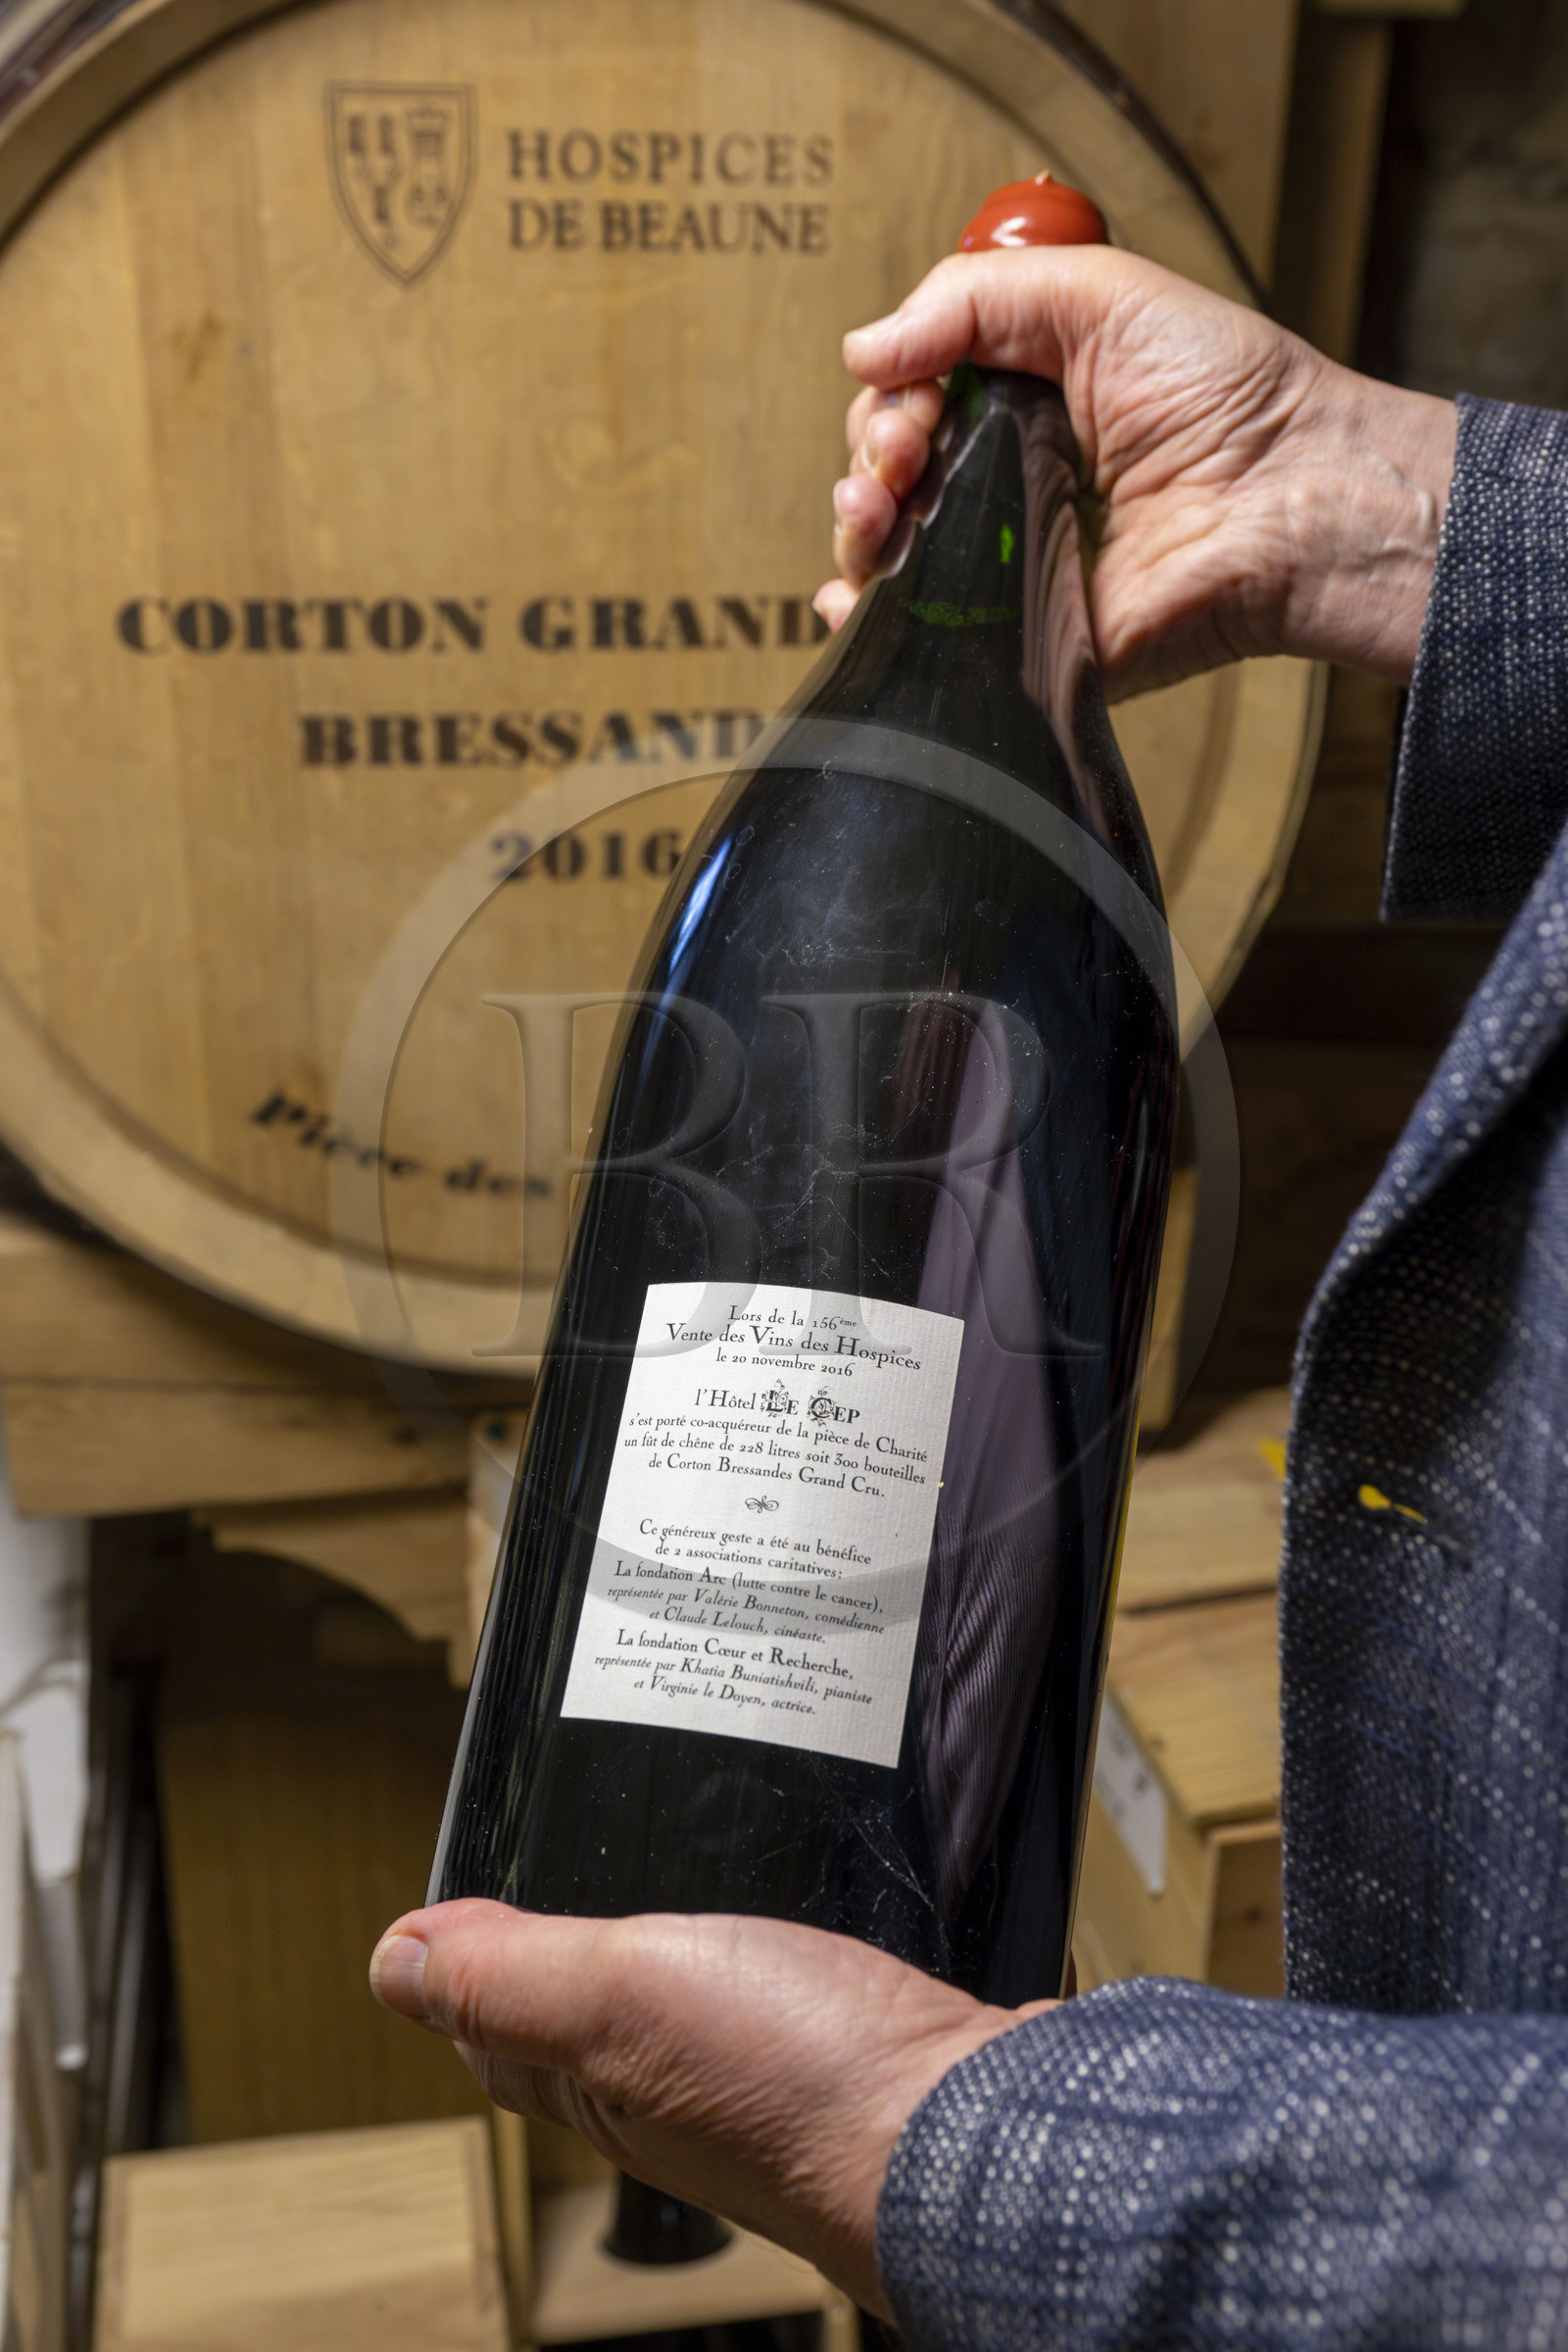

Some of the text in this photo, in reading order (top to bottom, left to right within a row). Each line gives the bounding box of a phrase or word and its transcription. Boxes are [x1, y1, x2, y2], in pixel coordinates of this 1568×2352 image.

[507, 126, 836, 189] HOSPICES
[508, 198, 831, 257] DE BEAUNE
[115, 595, 487, 656] CORTON
[490, 829, 685, 884] 2016
[444, 1159, 554, 1198] des
[728, 1305, 761, 1322] Lors
[768, 1308, 785, 1324] de
[791, 1310, 805, 1327] la
[666, 1323, 922, 1371] Vente des Vins des Hospices
[715, 1347, 857, 1378] le 20 novembre 2016
[761, 1382, 799, 1417] LE
[807, 1390, 860, 1426] CEP
[624, 1431, 926, 1485] un fût de chêne de 228 litres soit 300 bouteilles
[656, 1415, 686, 1431] porté
[690, 1418, 771, 1435] co-acquéreur
[776, 1420, 793, 1436] de
[796, 1422, 809, 1439] la
[813, 1429, 850, 1446] pièce
[854, 1432, 870, 1449] de
[875, 1436, 928, 1463] Charité
[648, 1452, 885, 1497] de Corton Bressandes Grand Cru.
[640, 1518, 871, 1565] Ce généreux geste a été au bénéfice
[655, 1540, 669, 1556] de
[673, 1547, 681, 1556] 2
[685, 1547, 762, 1566] associations
[607, 1587, 885, 1635] représentée par Valérie Bonneton, comédienne
[613, 1560, 884, 1615] La fondation Arc (lutte contre le cancer),
[649, 1605, 826, 1644] et Claude Lelouch, cinéaste.
[615, 1628, 854, 1680] La fondation Cœur et Recherche,
[594, 1654, 873, 1705] représentée par Khatia Buniatishvili, pianiste
[633, 1675, 816, 1715] et Virginie le Doyen, actrice.
